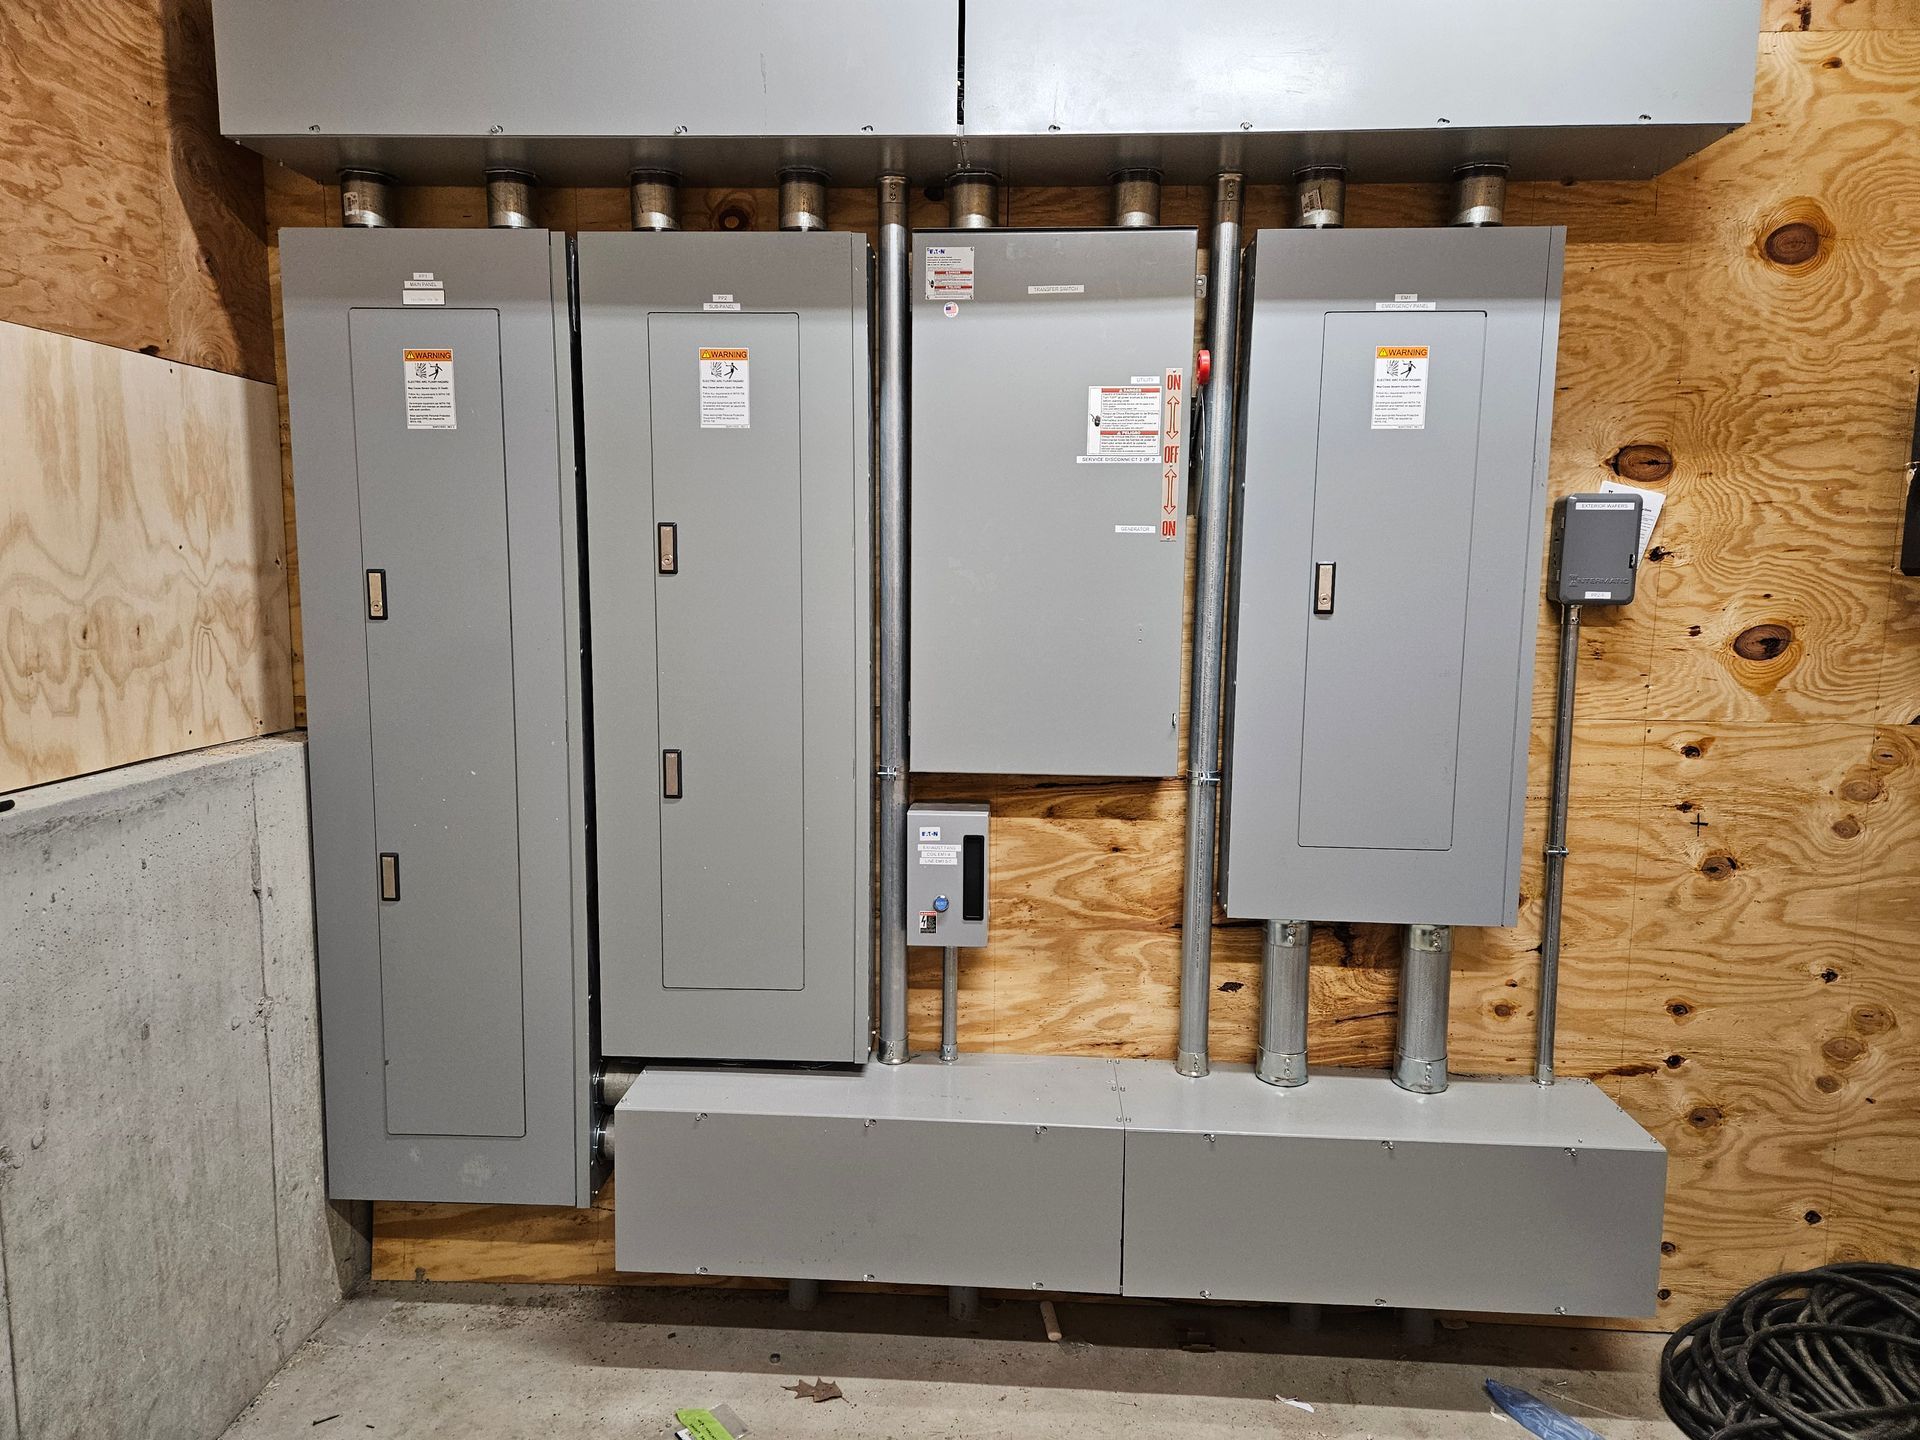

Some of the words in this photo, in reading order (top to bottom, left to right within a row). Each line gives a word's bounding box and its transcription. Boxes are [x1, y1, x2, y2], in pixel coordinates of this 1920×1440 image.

[710, 351, 747, 359] WARNING
[1389, 348, 1427, 356] WARNING
[1167, 374, 1181, 390] ON
[1164, 446, 1179, 463] OFF
[1162, 520, 1176, 536] ON
